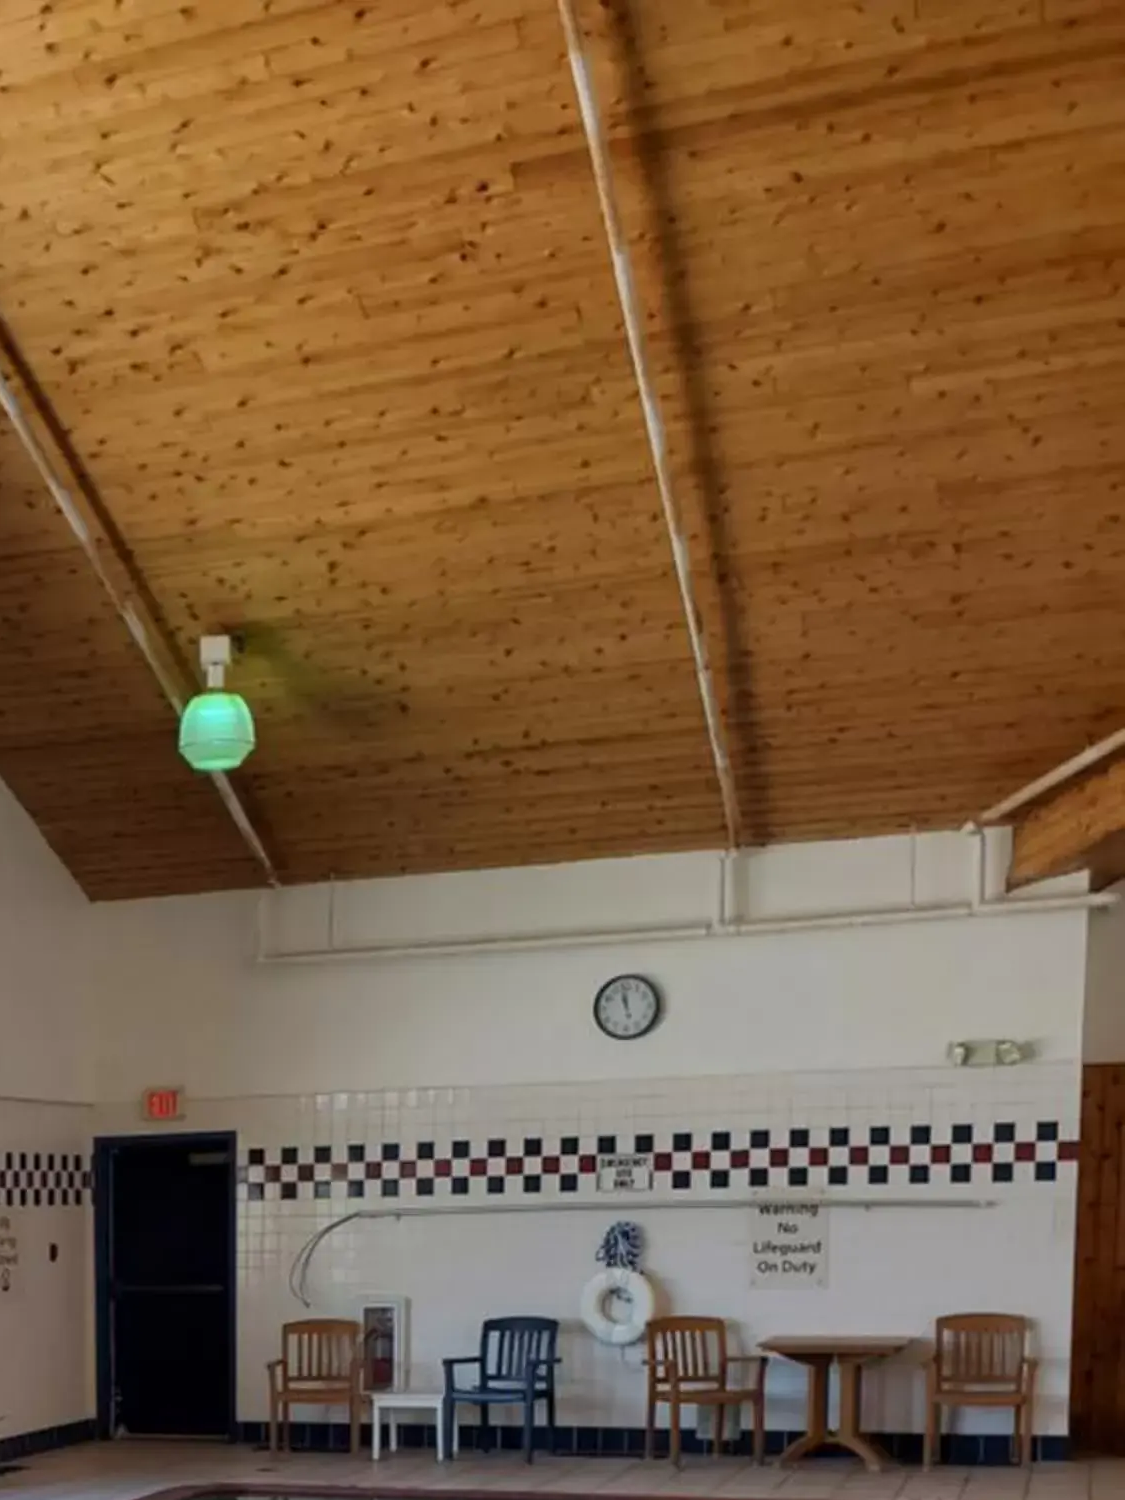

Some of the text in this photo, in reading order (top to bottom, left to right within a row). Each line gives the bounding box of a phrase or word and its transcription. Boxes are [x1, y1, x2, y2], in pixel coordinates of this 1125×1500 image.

[777, 1221, 799, 1234] No
[752, 1239, 822, 1257] Lifeguard
[756, 1259, 818, 1276] On Duty
